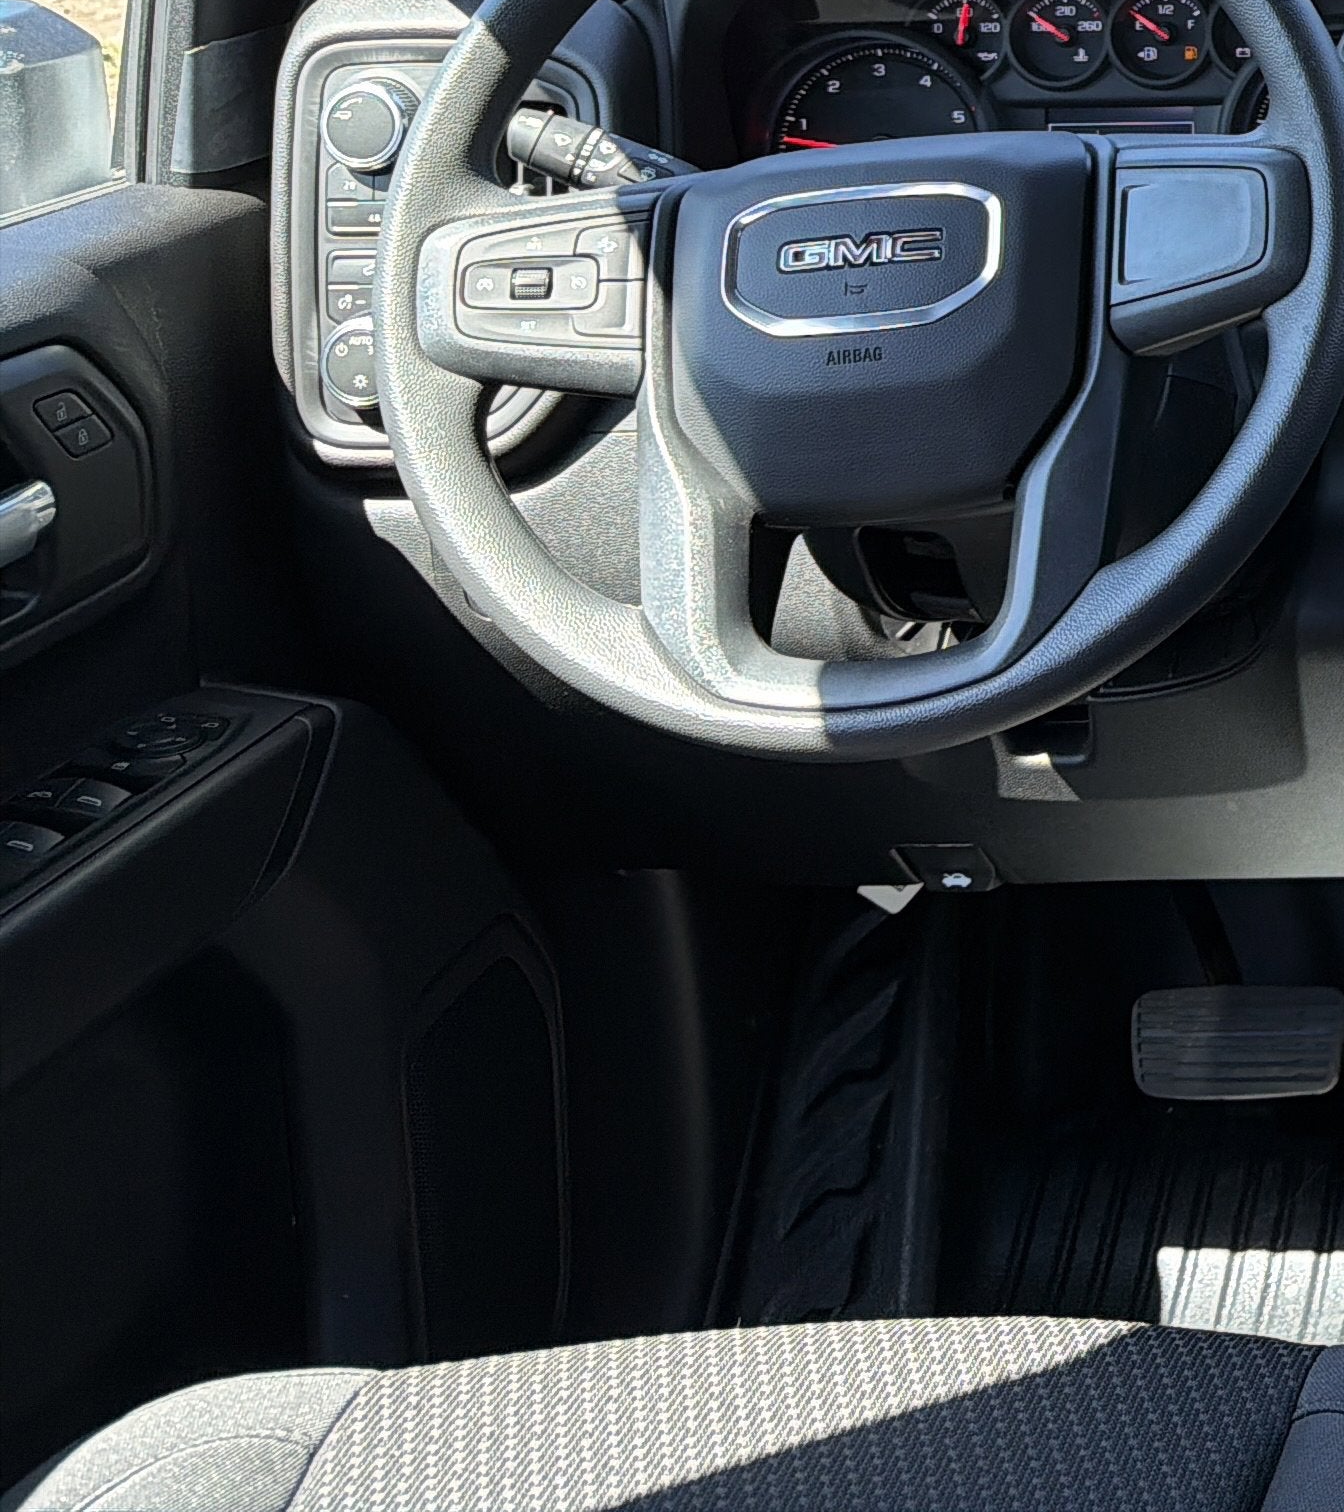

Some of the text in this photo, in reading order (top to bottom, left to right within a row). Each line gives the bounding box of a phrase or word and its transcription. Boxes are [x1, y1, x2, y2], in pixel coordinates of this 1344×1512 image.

[1055, 5, 1077, 17] 210
[1158, 4, 1175, 15] 1/2
[979, 22, 1001, 33] 120
[1077, 20, 1102, 32] 260
[1187, 19, 1195, 30] F
[872, 63, 885, 77] 3
[827, 80, 841, 94] 2
[919, 74, 932, 88] 4
[950, 110, 965, 124] 5
[800, 118, 808, 131] 1
[779, 231, 942, 272] GMC
[826, 347, 884, 366] AIRBAG
